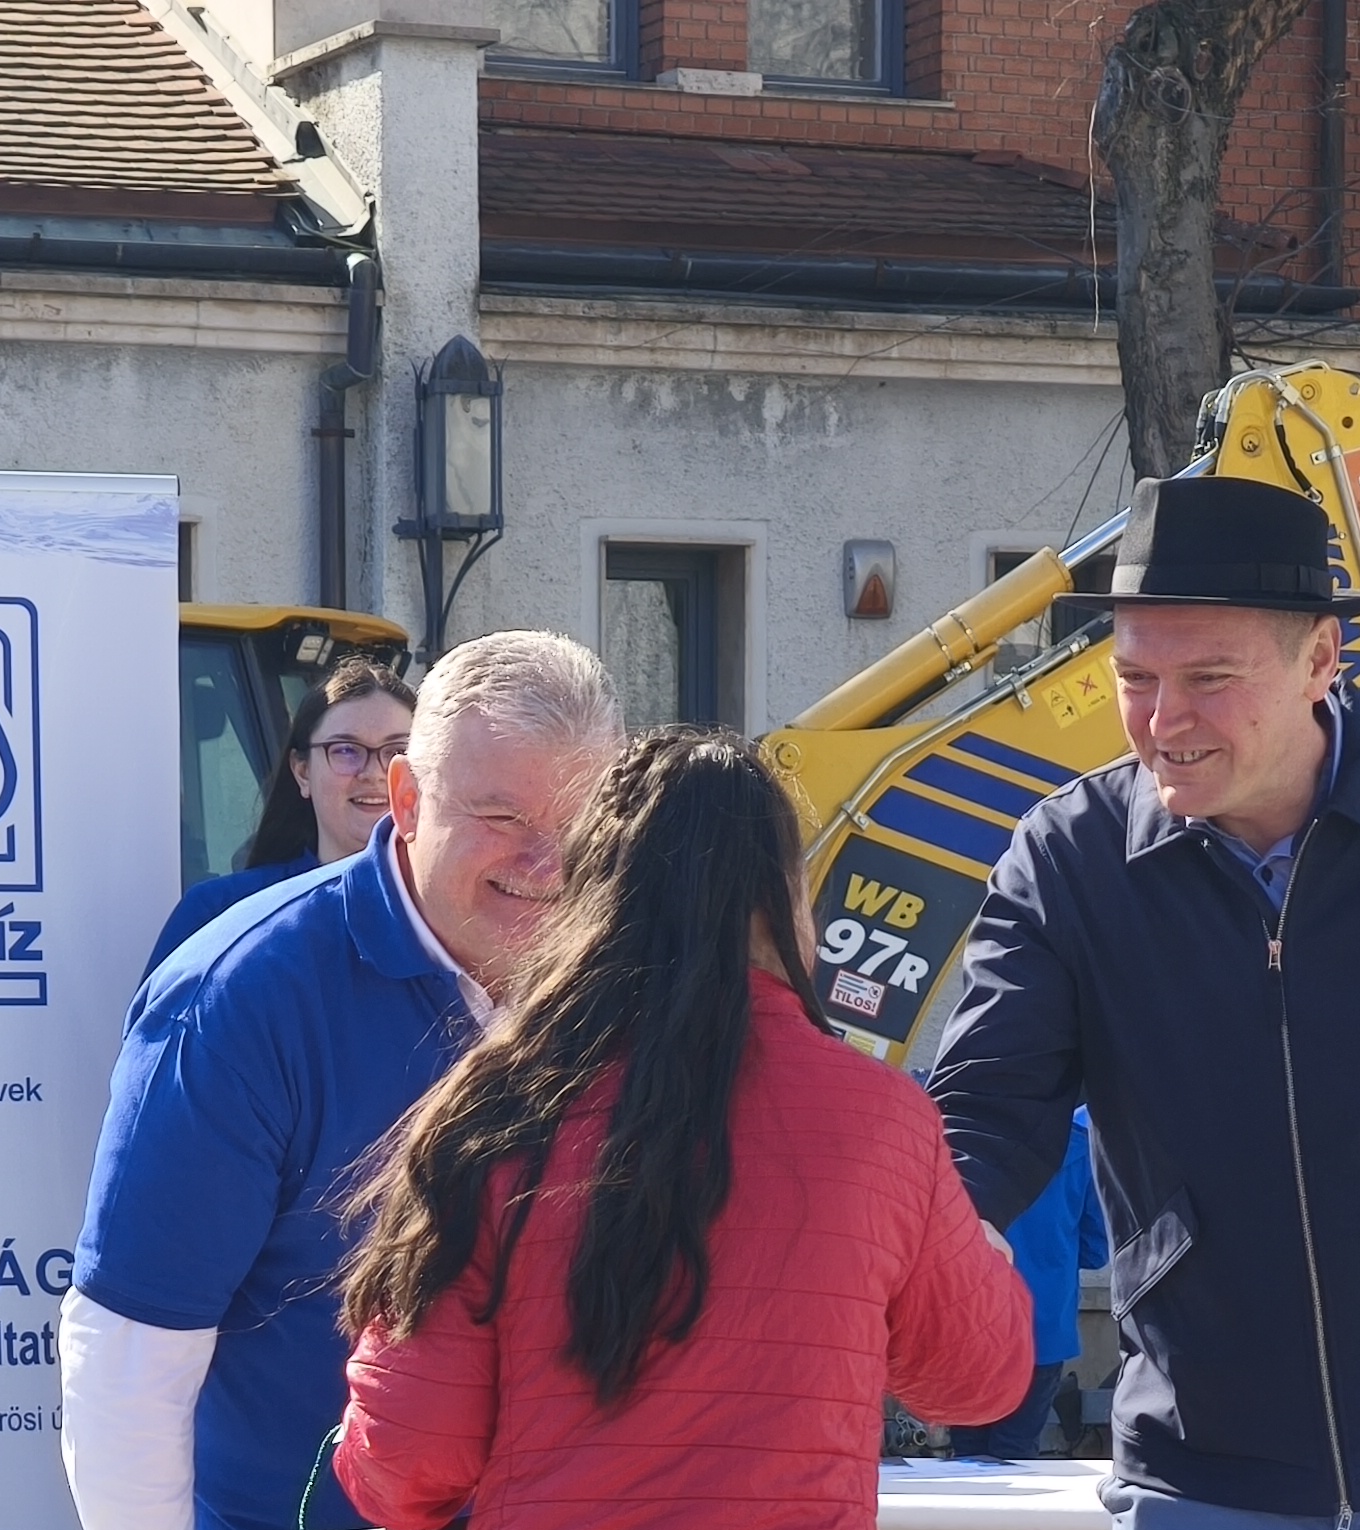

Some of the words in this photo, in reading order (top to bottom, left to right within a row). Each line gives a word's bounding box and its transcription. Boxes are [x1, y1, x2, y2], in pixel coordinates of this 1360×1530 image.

[844, 873, 925, 930] WB
[817, 918, 930, 994] 97R
[834, 988, 877, 1013] TILOS!
